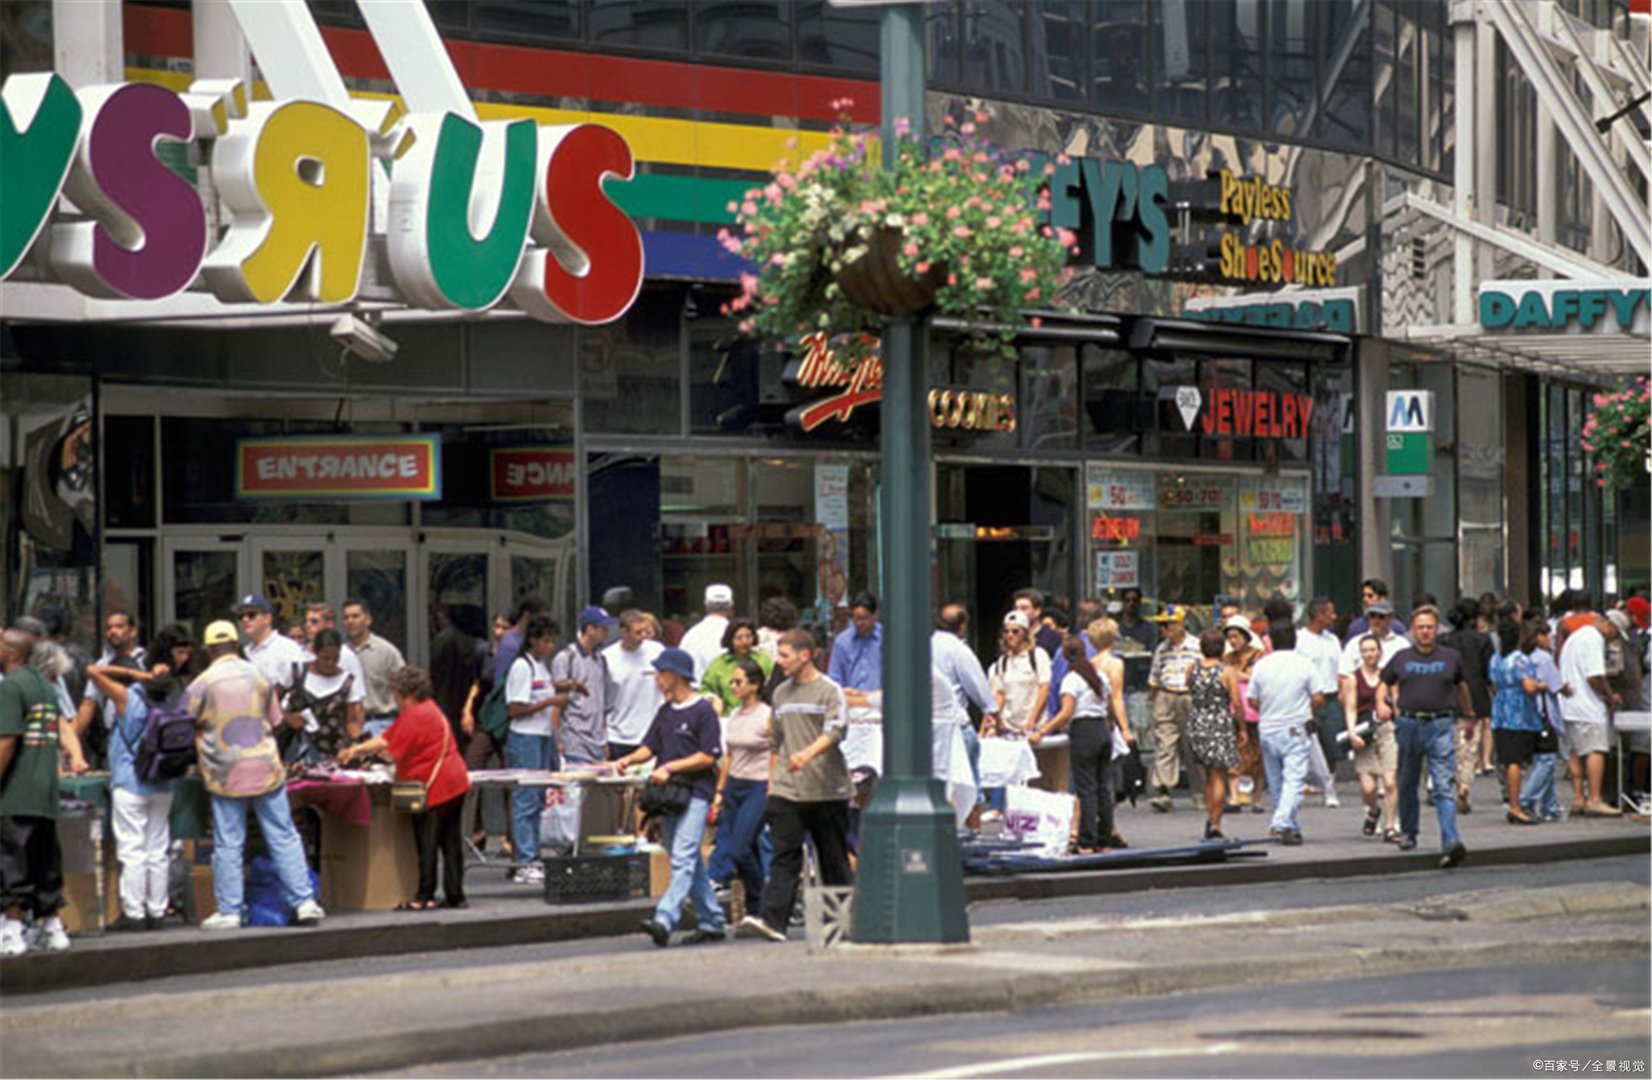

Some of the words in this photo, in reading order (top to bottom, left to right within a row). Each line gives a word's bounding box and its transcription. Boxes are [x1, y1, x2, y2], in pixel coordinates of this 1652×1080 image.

[426, 111, 643, 324] US
[1219, 170, 1290, 225] Payless
[1219, 232, 1336, 285] ShoeSource
[1203, 387, 1313, 440] JEWELRY
[257, 454, 418, 482] ENTRANCE
